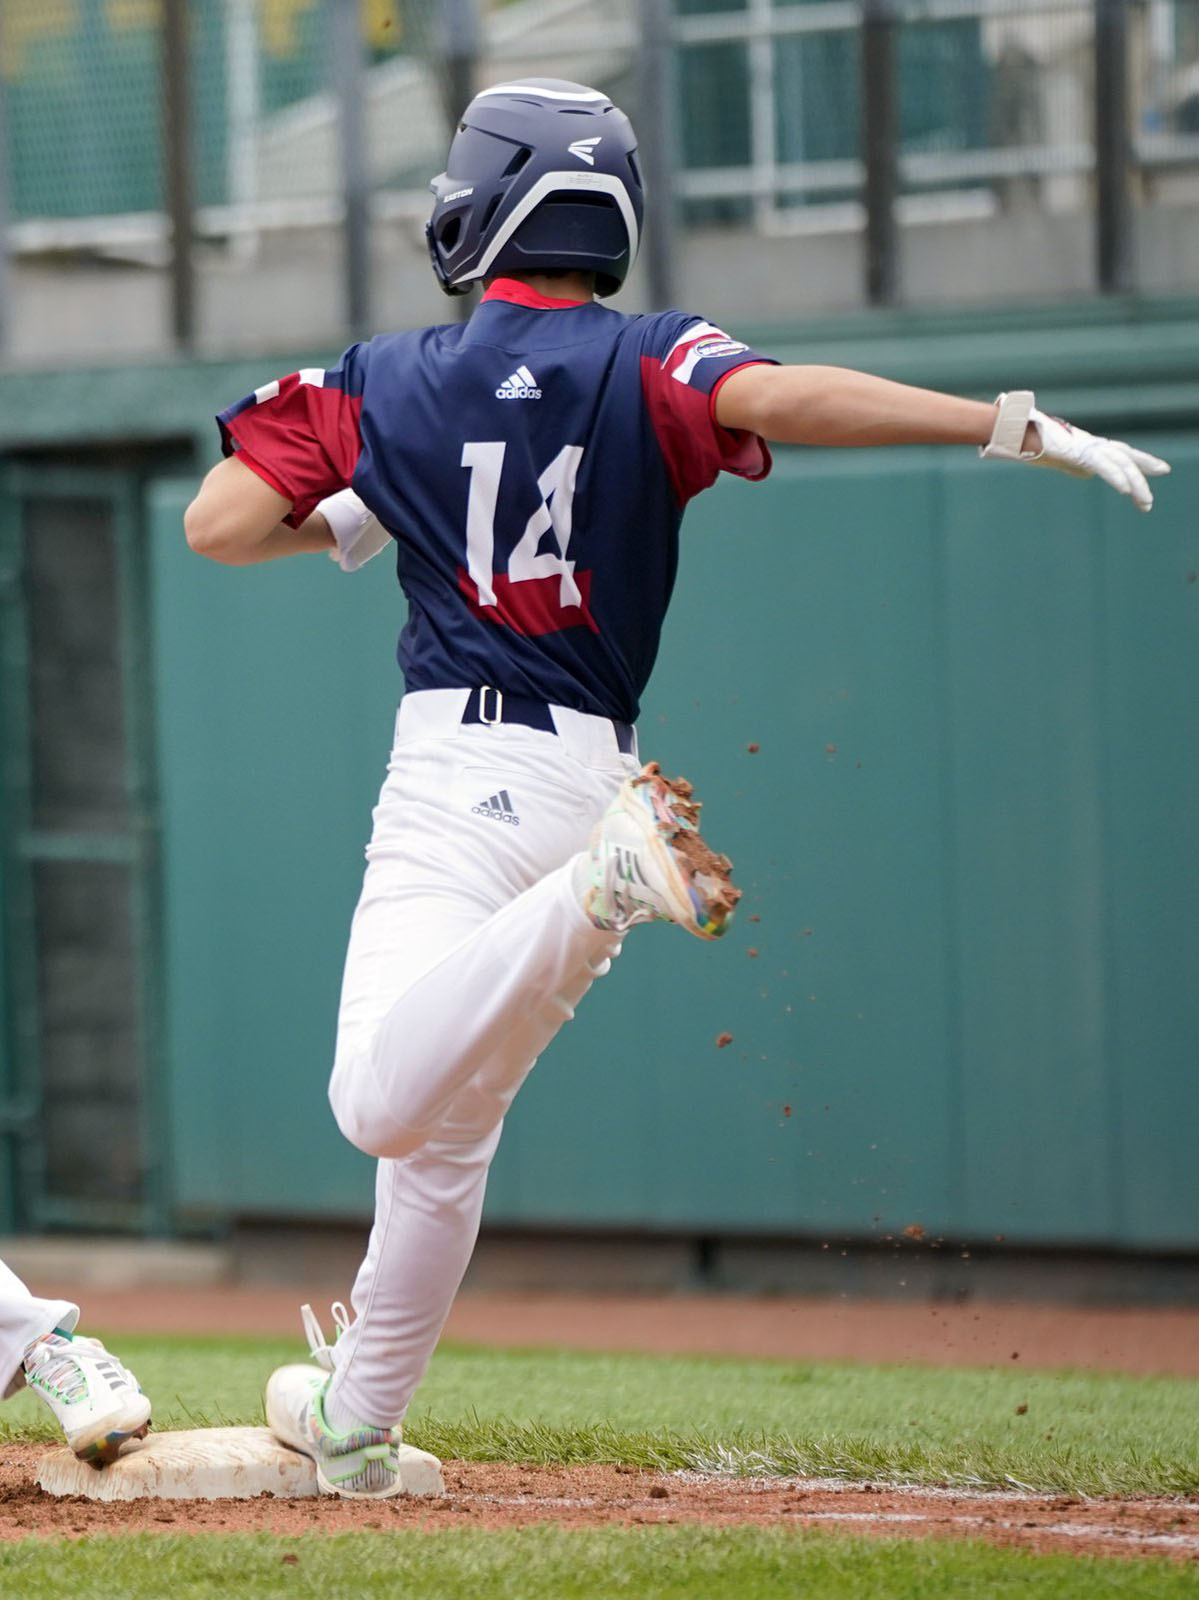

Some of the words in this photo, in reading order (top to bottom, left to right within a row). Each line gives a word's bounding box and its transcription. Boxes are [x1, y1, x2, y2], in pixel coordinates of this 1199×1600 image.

[495, 385, 543, 400] adidas
[460, 441, 585, 609] 14
[471, 806, 520, 826] adidas
